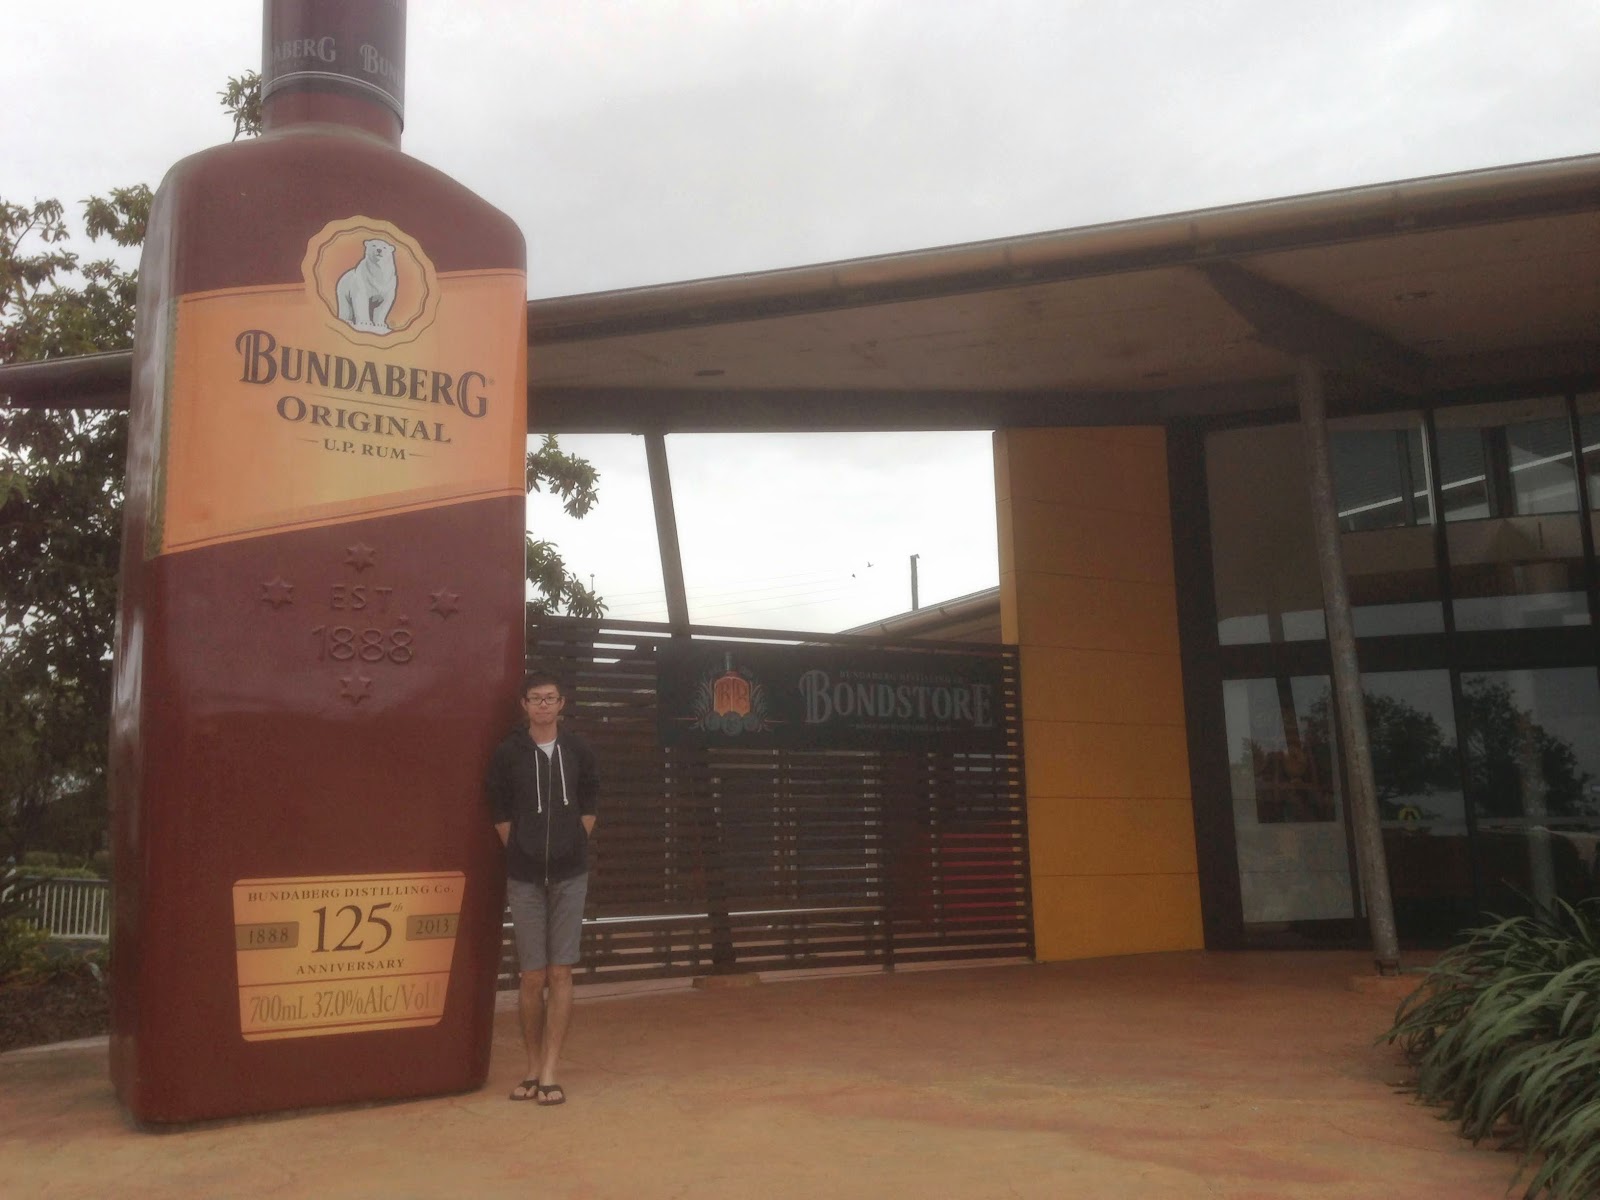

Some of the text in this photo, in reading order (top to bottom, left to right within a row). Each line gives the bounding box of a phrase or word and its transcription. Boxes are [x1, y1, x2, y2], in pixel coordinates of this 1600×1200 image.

[235, 329, 488, 418] BUNDABERG
[276, 395, 452, 443] ORIGINAL
[323, 438, 407, 461] U.P. RUM
[330, 584, 393, 614] EST
[311, 624, 414, 665] 1888
[799, 669, 993, 728] BONDSTORE
[248, 889, 340, 902] BUNDABERG
[344, 885, 430, 898] DISTILLING
[249, 926, 289, 945] 1888
[415, 917, 450, 936] 2013
[296, 957, 406, 976] ANNIVERSARY
[250, 993, 309, 1023] 700mL
